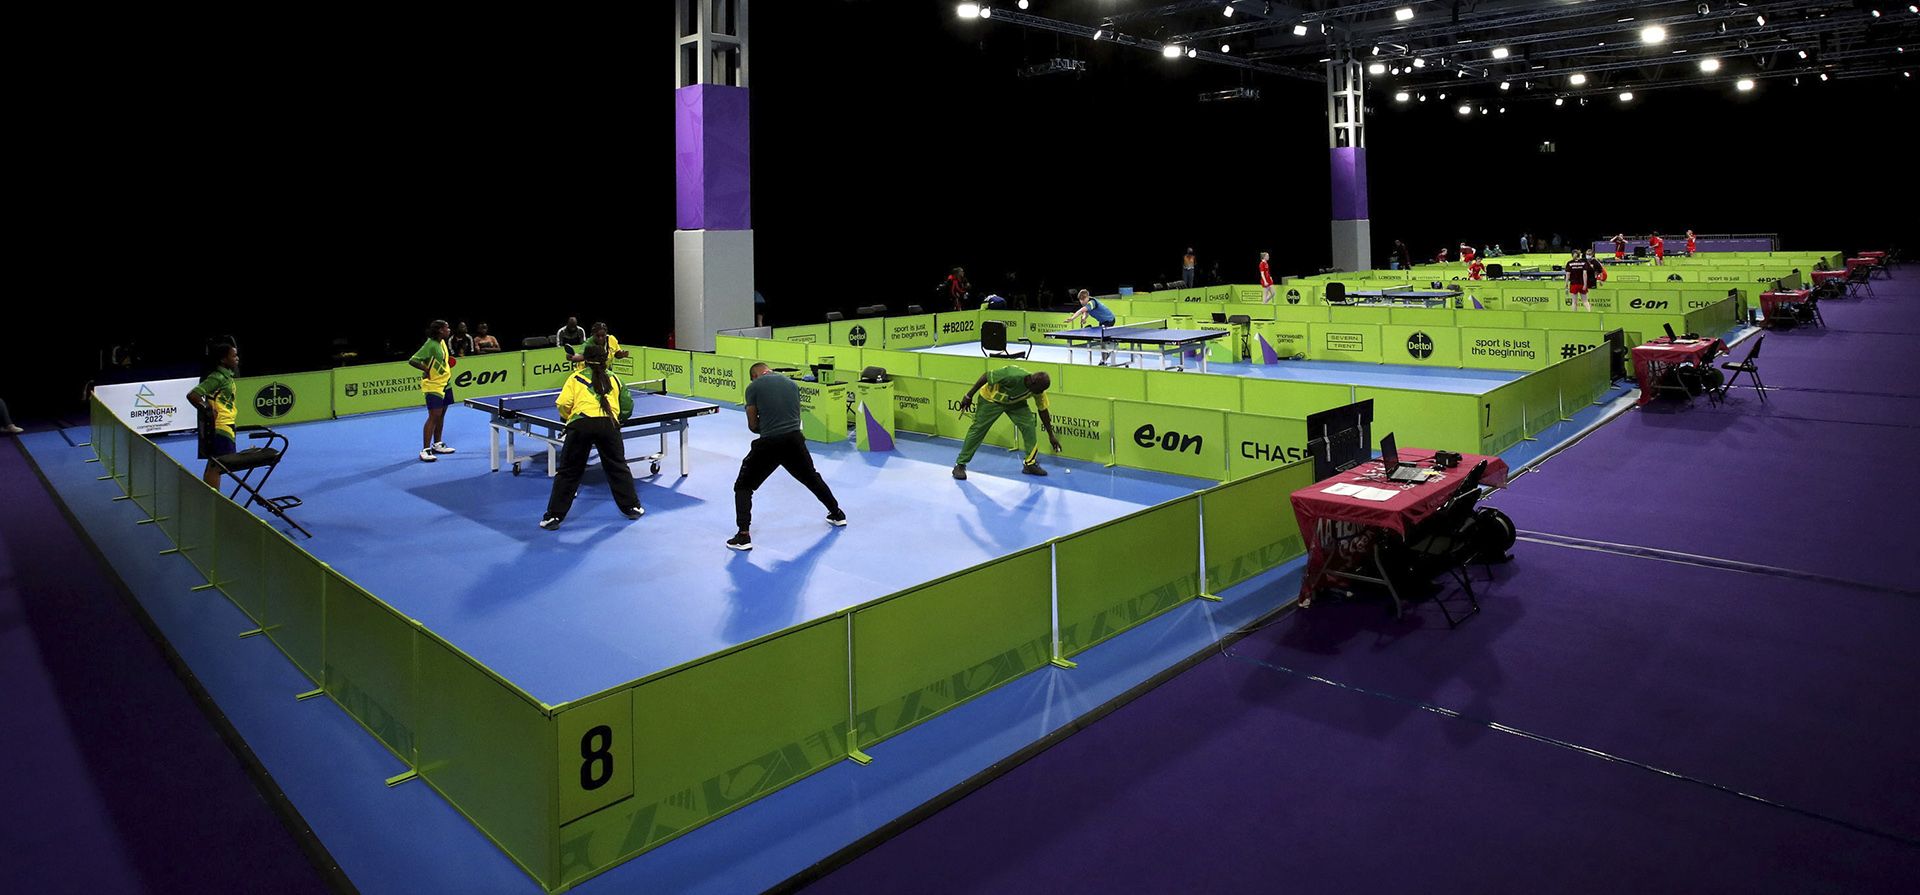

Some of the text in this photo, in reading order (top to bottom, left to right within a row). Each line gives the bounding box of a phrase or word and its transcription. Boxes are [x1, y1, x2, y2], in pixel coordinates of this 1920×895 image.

[894, 325, 908, 333] sport
[943, 320, 974, 334] #B2022
[901, 330, 928, 340] beginning
[1408, 341, 1432, 351] Dettol
[1475, 339, 1531, 349] sport is just
[1471, 347, 1535, 359] the beginning
[652, 362, 683, 374] LONGINES
[701, 366, 733, 378] sport is just
[362, 377, 417, 389] UNIVERSITY
[698, 374, 736, 390] the beginning
[256, 394, 292, 408] Dettol
[900, 402, 919, 410] games
[130, 407, 177, 418] BIRMINGHAM
[144, 415, 163, 424] 2022
[1041, 423, 1100, 440] BRMINGHAM
[581, 725, 614, 791] 8
